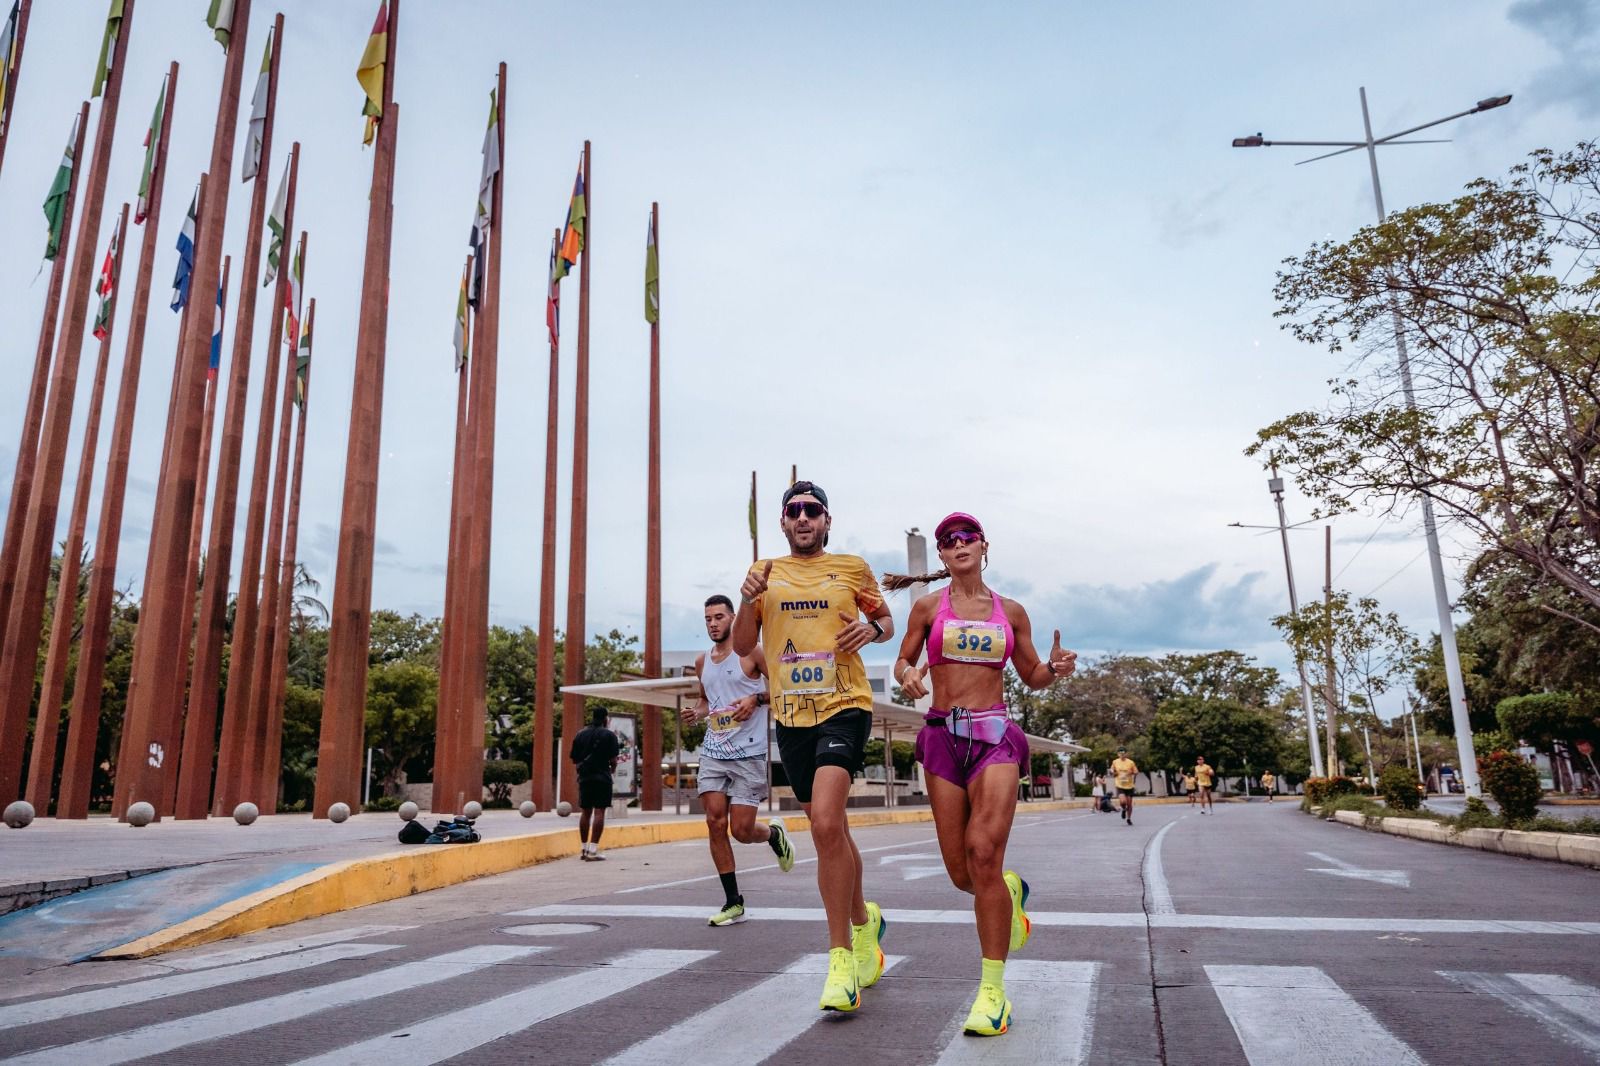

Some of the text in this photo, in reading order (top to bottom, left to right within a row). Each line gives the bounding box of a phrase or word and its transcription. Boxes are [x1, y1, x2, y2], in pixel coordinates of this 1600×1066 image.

[781, 600, 829, 611] mmvu
[957, 633, 992, 652] 392
[791, 666, 824, 684] 608
